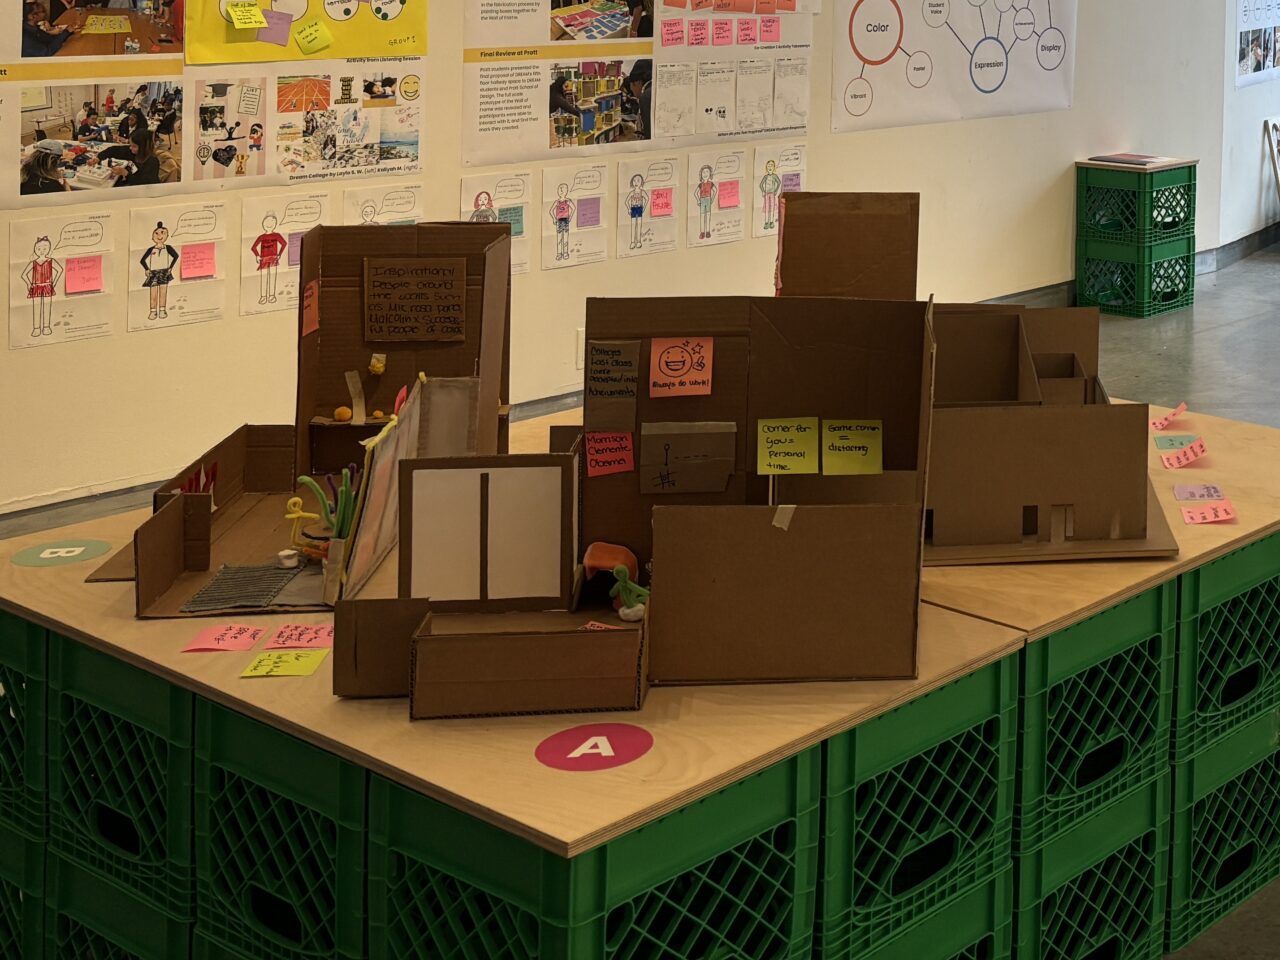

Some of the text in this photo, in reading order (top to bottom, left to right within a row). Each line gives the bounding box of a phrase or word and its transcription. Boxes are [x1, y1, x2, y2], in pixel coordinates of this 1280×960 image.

[866, 23, 889, 33] Color
[1040, 43, 1061, 54] Display
[974, 60, 1004, 70] Expression
[308, 172, 329, 180] Collage
[329, 171, 336, 179] by
[795, 424, 812, 433] for
[40, 547, 86, 558] B
[566, 736, 615, 758] A
